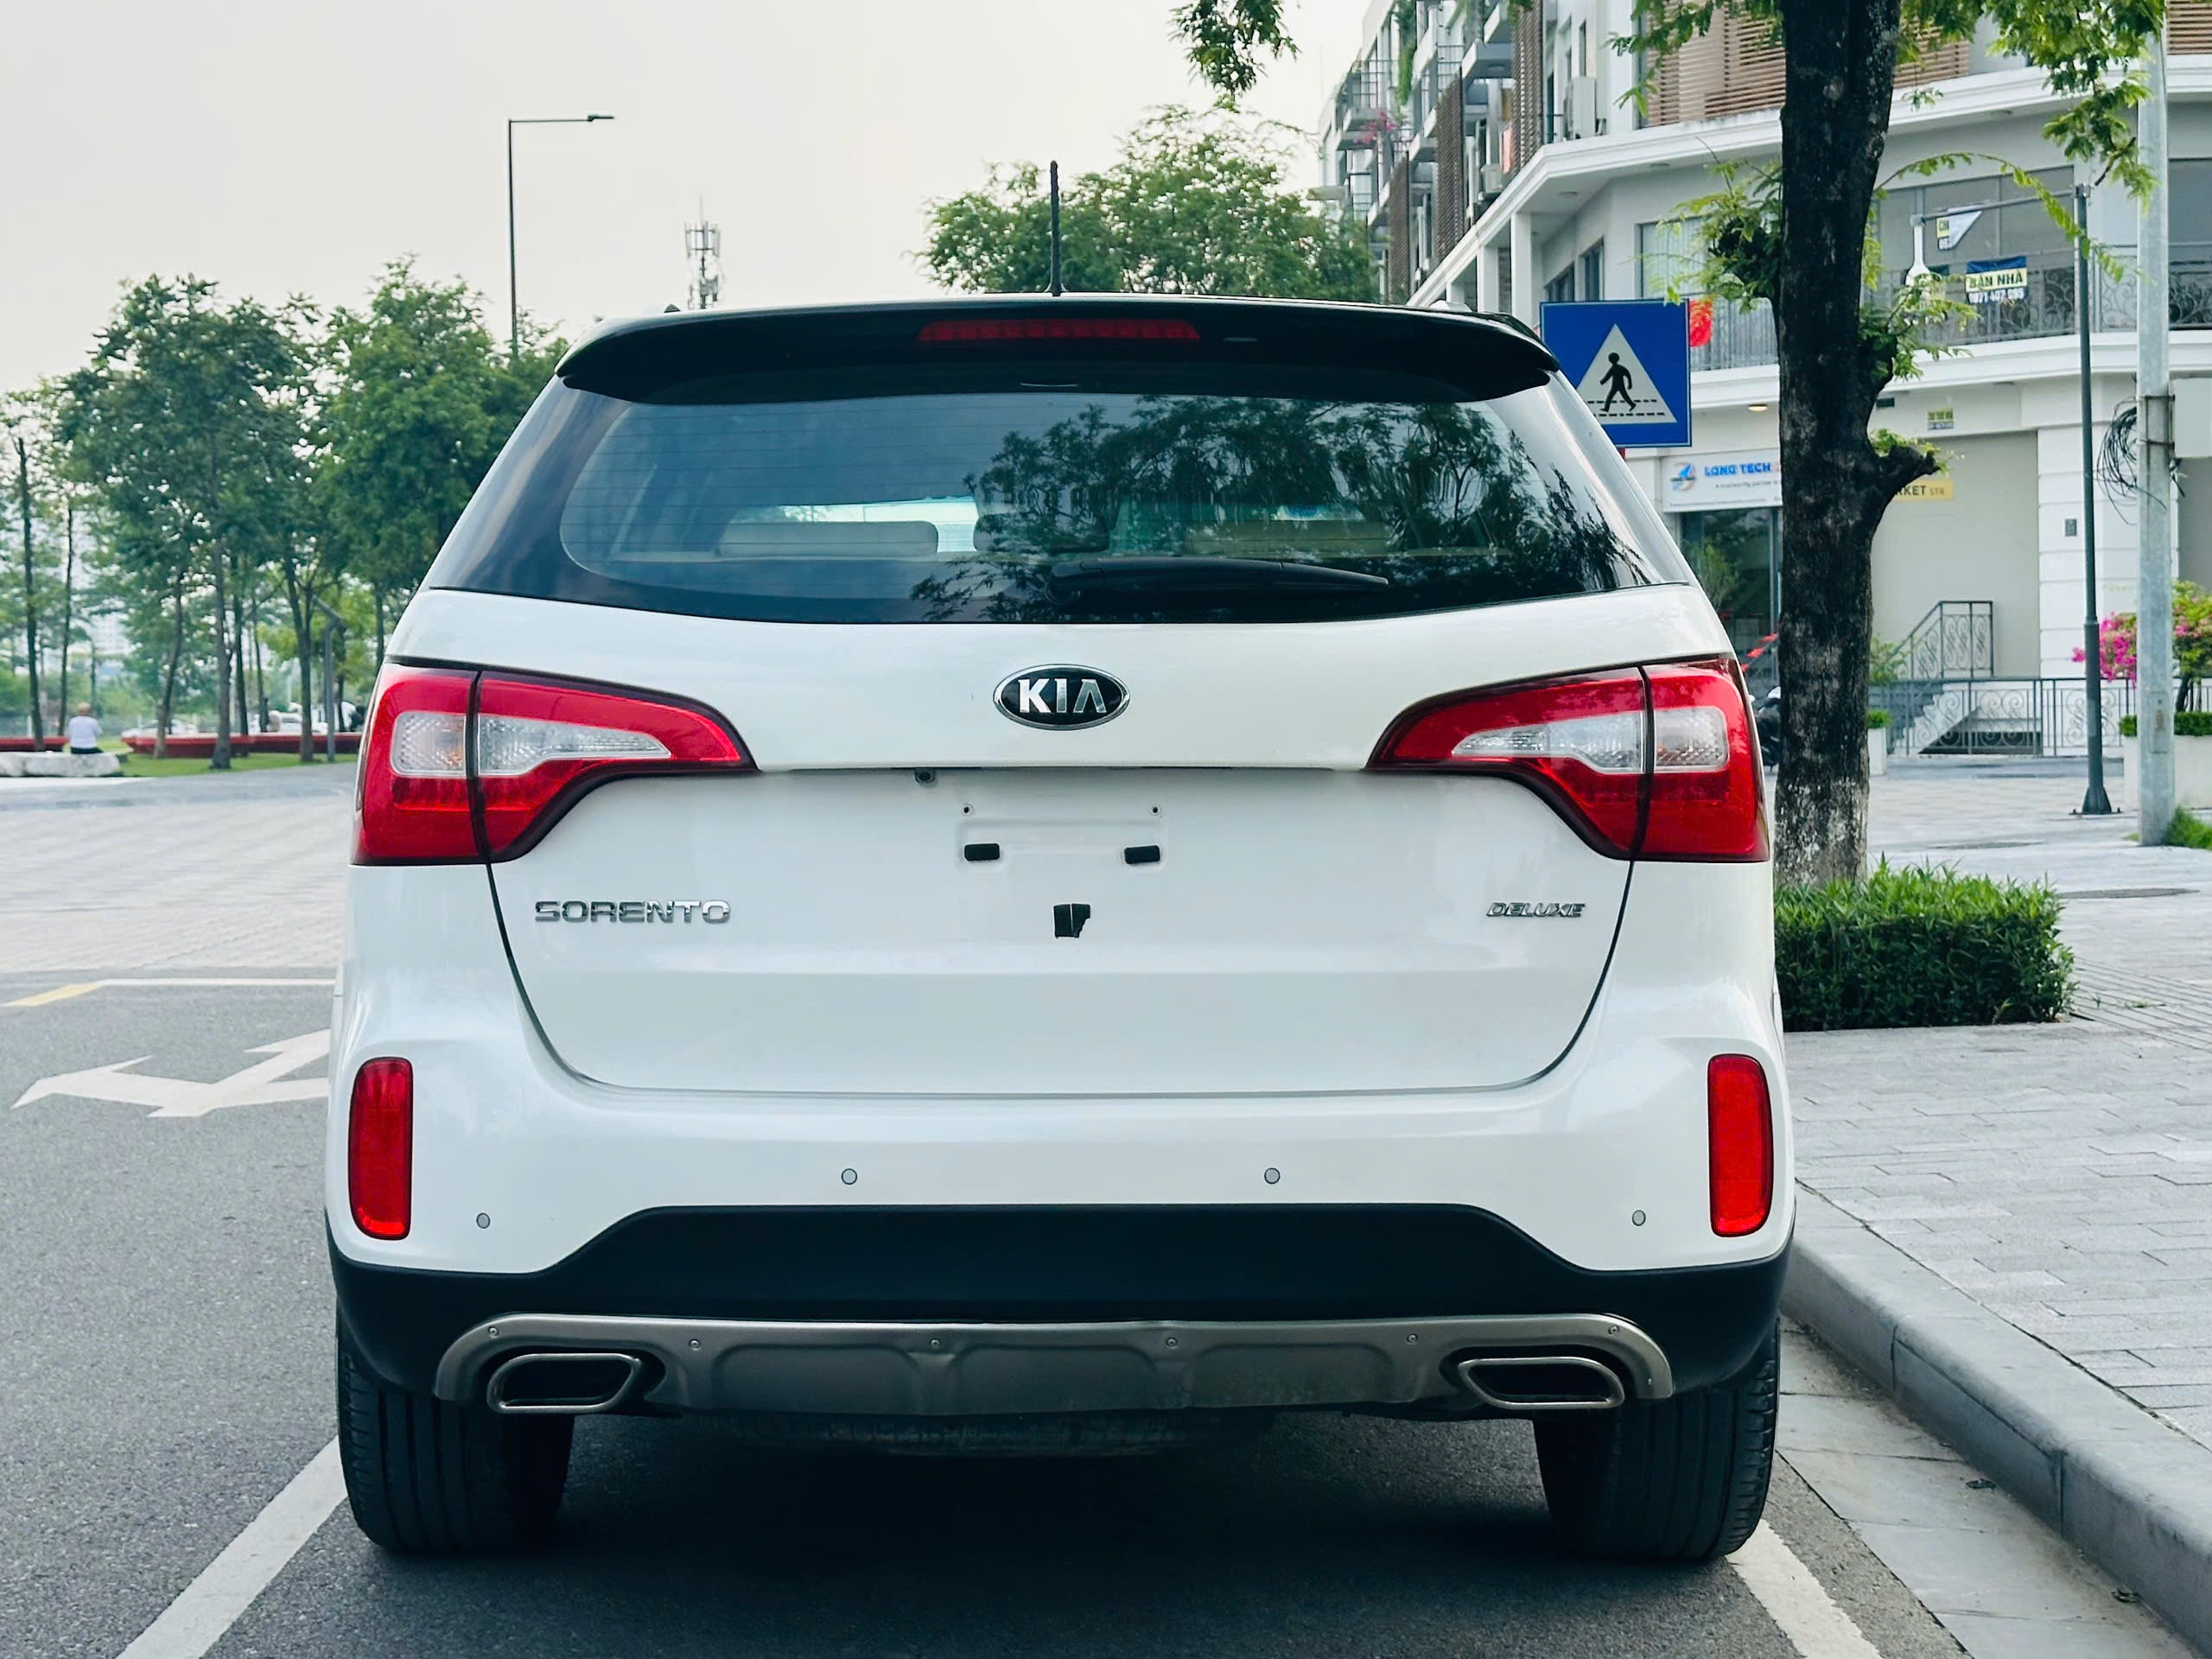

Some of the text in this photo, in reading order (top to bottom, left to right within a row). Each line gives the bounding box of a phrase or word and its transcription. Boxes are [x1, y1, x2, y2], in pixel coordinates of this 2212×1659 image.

[1997, 270, 2023, 286] NHÀ
[1704, 464, 1737, 477] LONG
[1739, 461, 1771, 474] TECH
[1017, 677, 1108, 714] KIA
[534, 899, 731, 924] SORENTO
[1486, 902, 1586, 918] DELUXE
